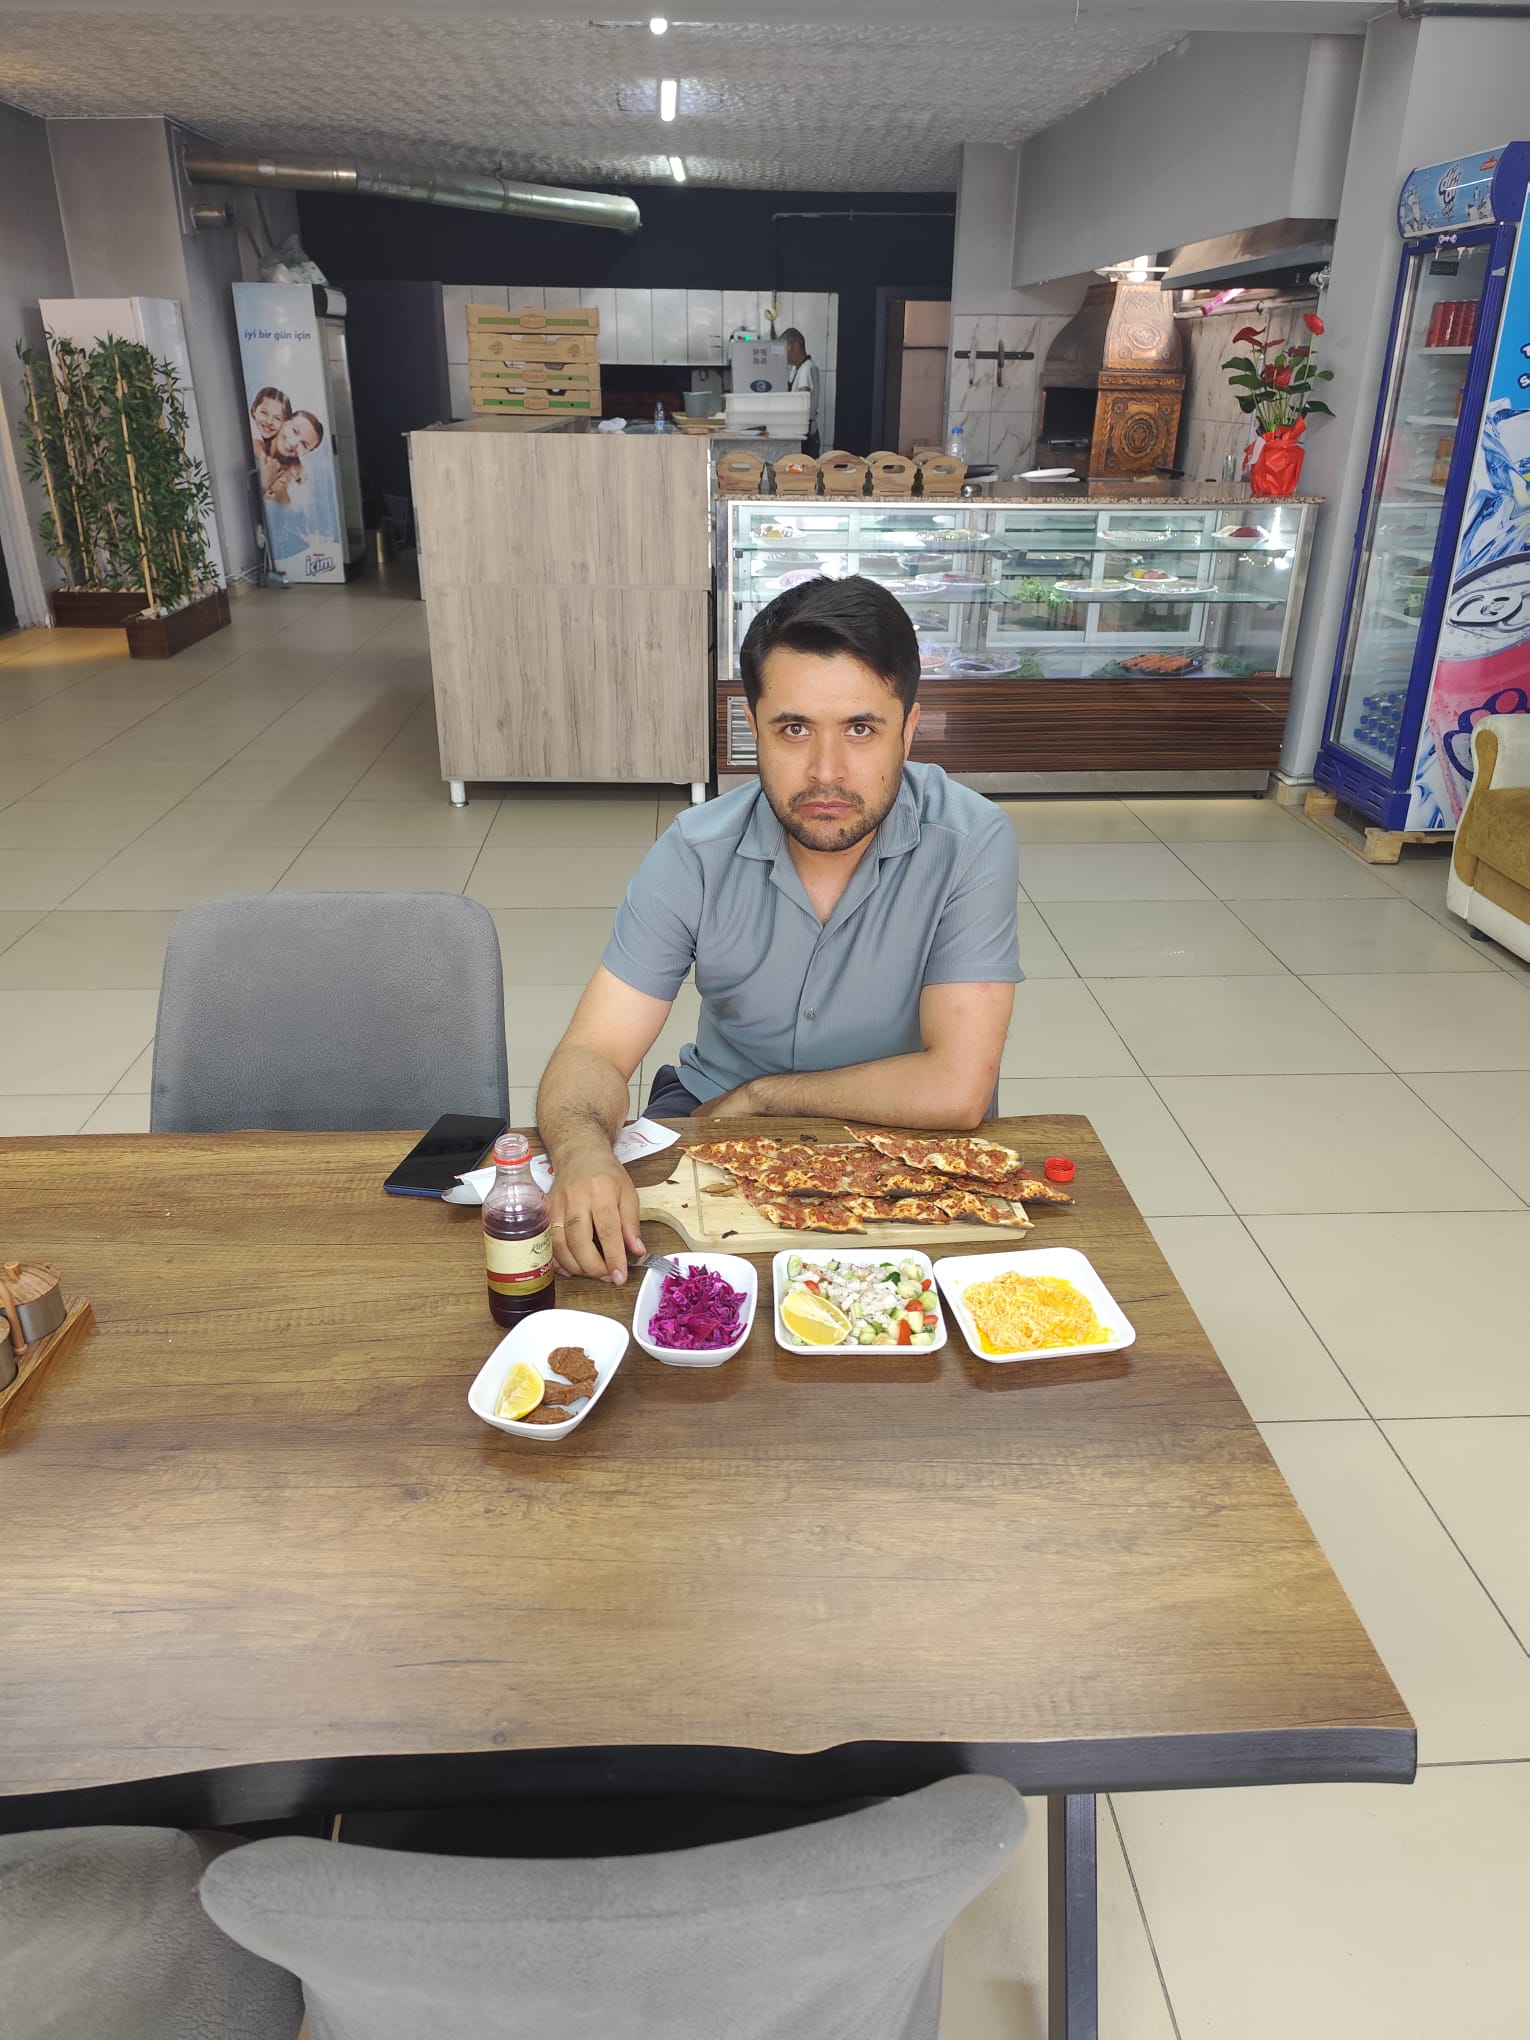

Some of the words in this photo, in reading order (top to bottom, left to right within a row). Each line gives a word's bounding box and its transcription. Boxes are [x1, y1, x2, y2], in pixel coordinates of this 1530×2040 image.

[244, 329, 257, 341] iyi
[259, 328, 272, 340] bir
[274, 330, 292, 342] gün
[294, 330, 312, 343] için
